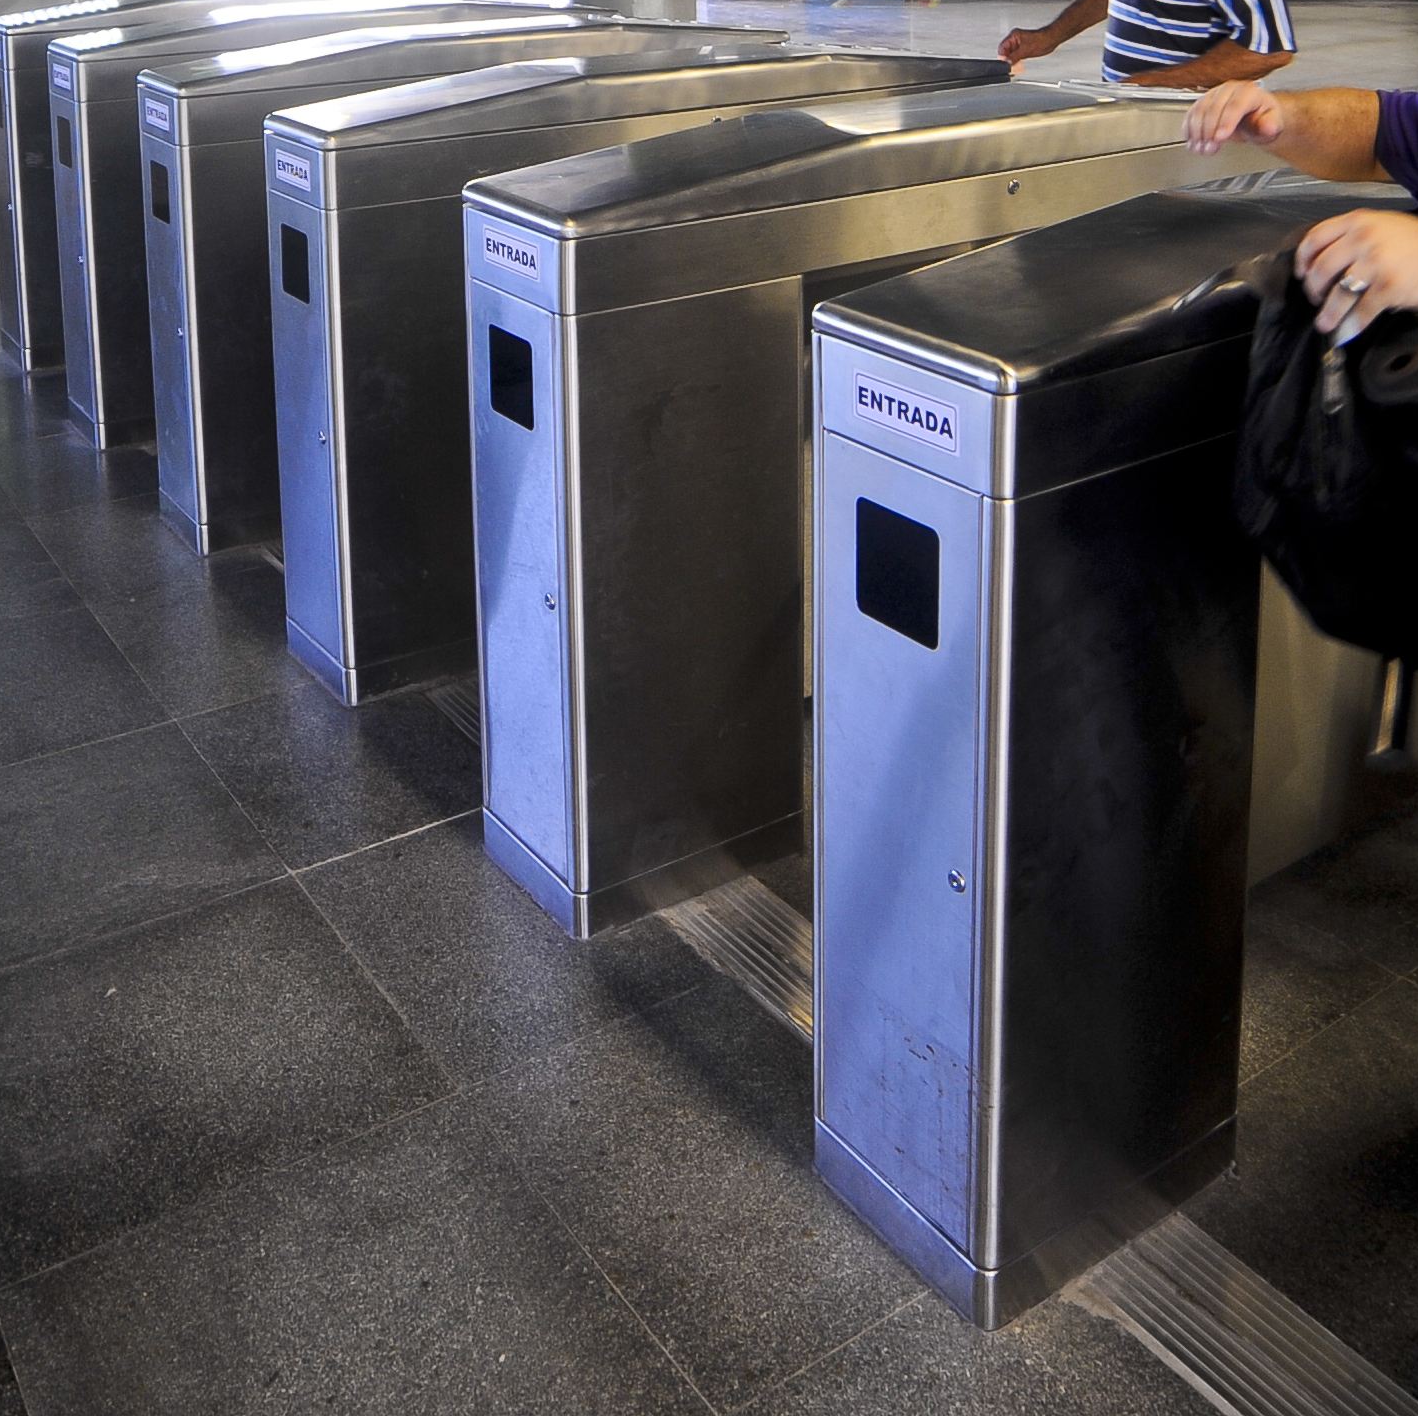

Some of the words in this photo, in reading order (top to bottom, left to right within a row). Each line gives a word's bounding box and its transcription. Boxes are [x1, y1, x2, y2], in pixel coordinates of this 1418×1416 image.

[277, 159, 309, 182] ENTRADA
[486, 237, 537, 271] ENTRADA
[858, 385, 954, 439] ENTRADA
